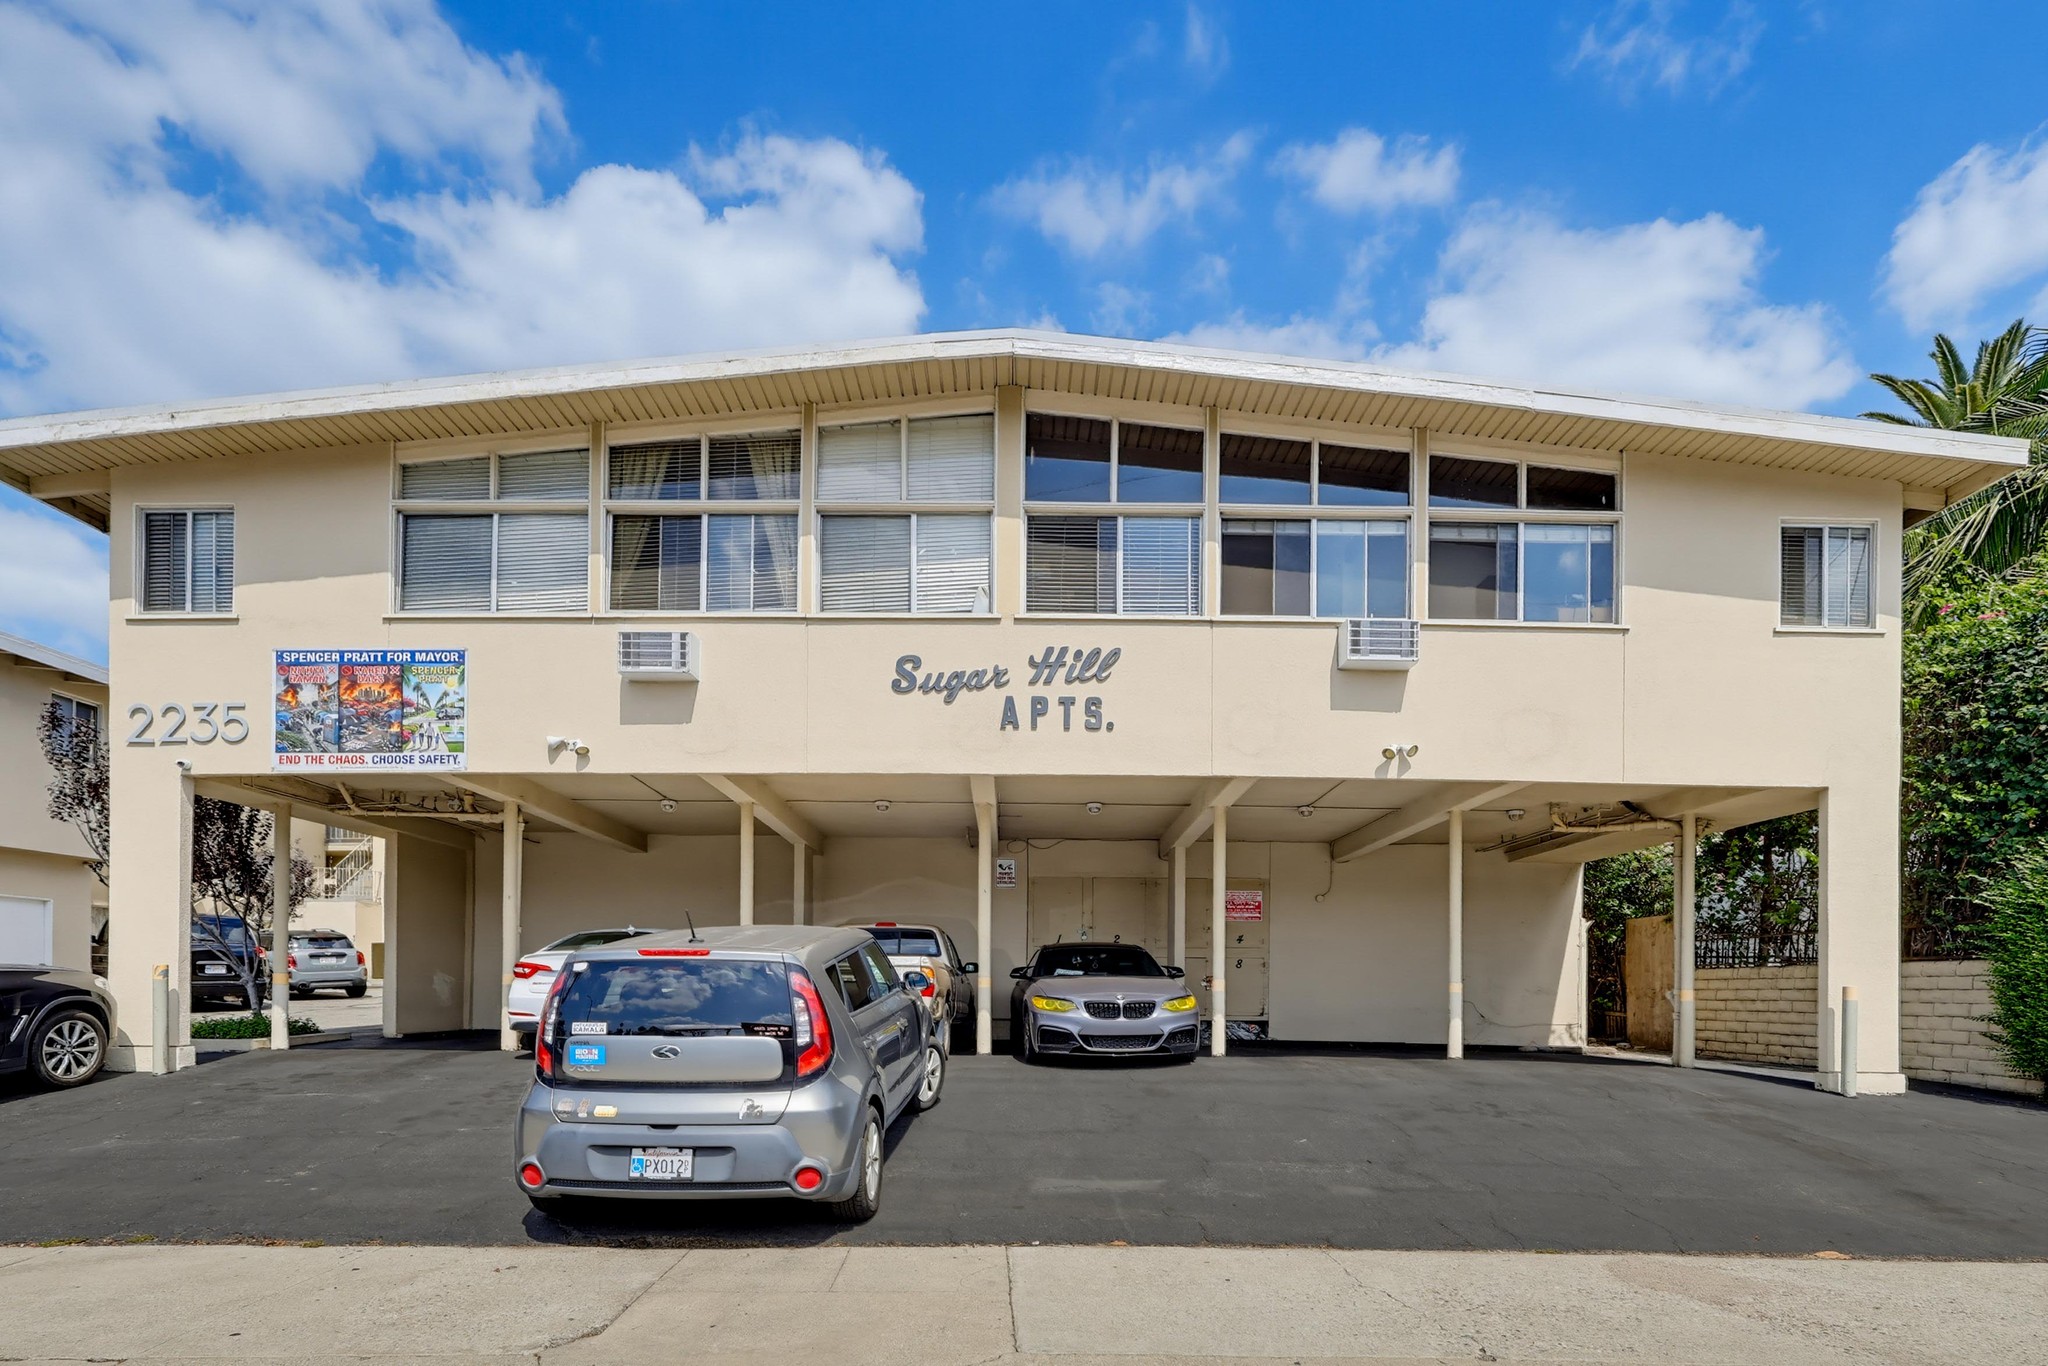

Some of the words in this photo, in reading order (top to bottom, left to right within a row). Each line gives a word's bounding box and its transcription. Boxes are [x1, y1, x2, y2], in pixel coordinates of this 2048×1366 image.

[283, 652, 340, 663] SPENCER
[344, 652, 384, 663] PRATT
[387, 652, 411, 662] FOR
[415, 652, 459, 663] MAYOR
[411, 665, 456, 675] SPENCER
[891, 654, 1010, 706] Sugar
[1028, 646, 1122, 687] Hill
[1000, 695, 1114, 732] APTS.
[127, 702, 250, 747] 2235
[278, 754, 301, 765] END
[304, 754, 329, 765] THE
[330, 754, 369, 765] CHAOS.
[372, 754, 415, 765] CHOOSE
[418, 754, 461, 765] SAFETY.
[1113, 934, 1121, 944] 2
[1235, 958, 1243, 969] 8
[644, 1159, 684, 1174] PX012
